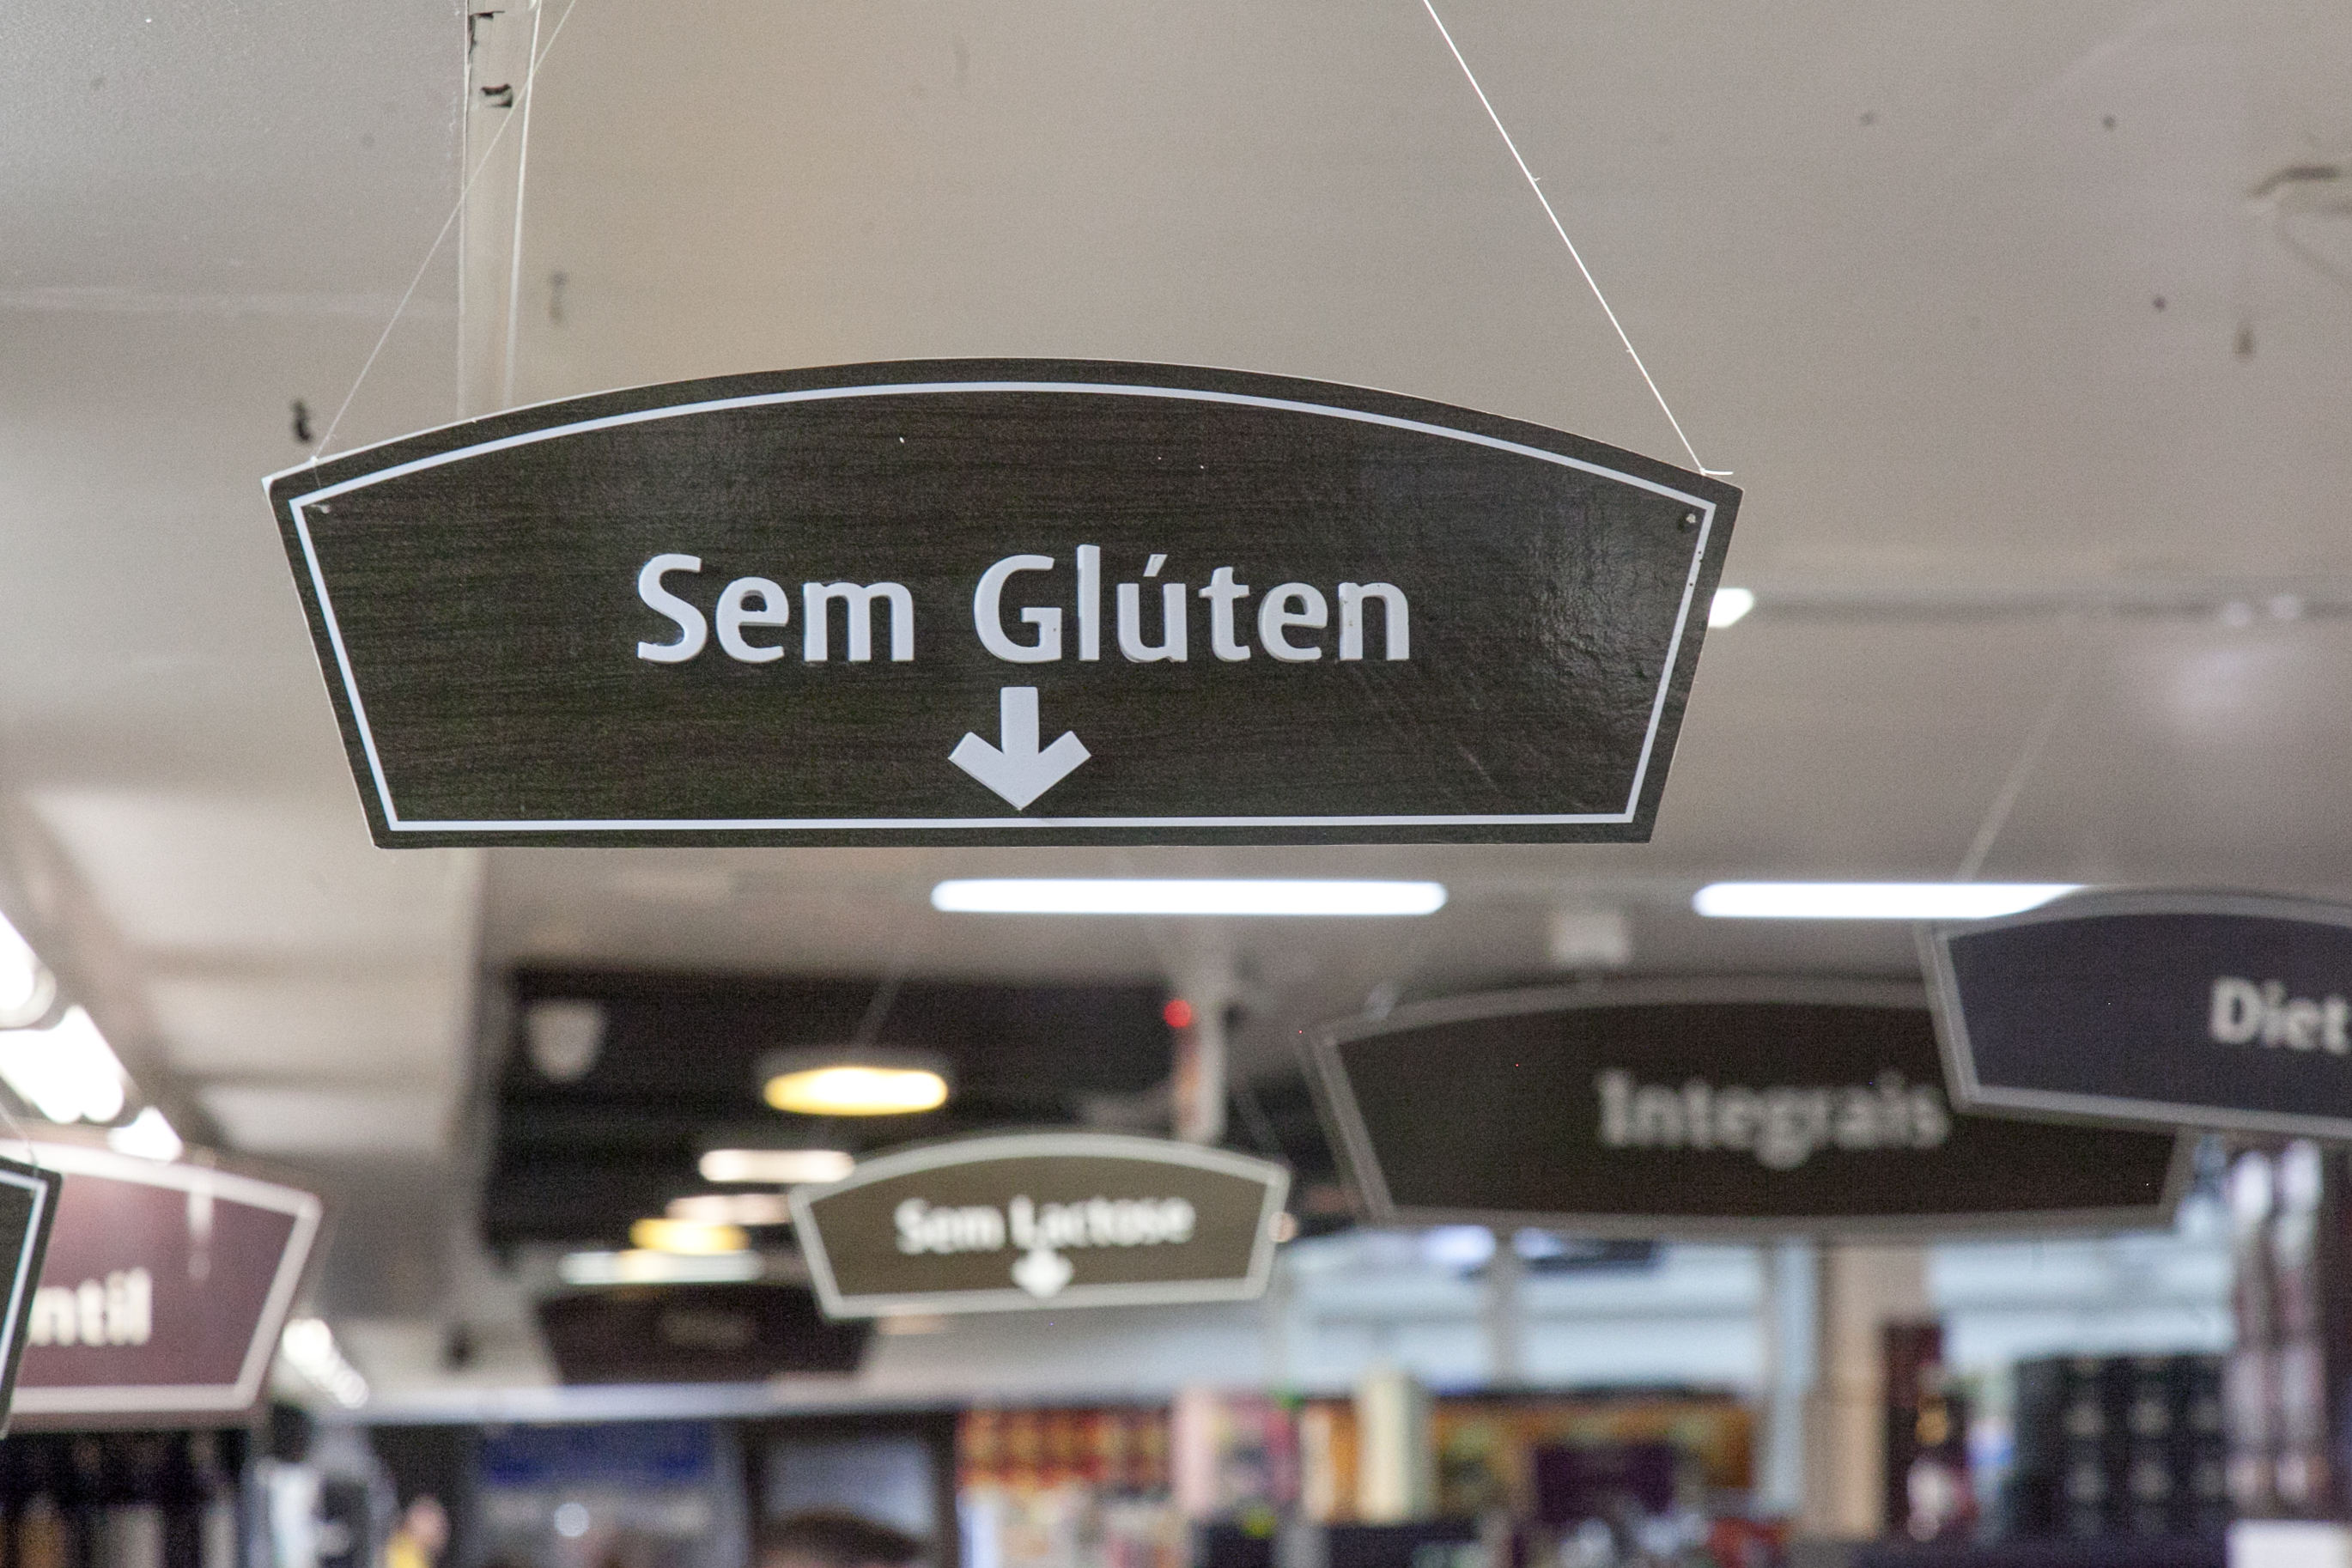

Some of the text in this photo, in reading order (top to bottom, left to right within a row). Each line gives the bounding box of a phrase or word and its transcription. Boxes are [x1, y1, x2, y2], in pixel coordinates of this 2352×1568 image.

[636, 544, 1411, 664] Sem Glúten
[2210, 976, 2352, 1054] Diet
[1597, 1069, 1949, 1169] Integrais
[895, 1194, 1196, 1255] Sem Lactose
